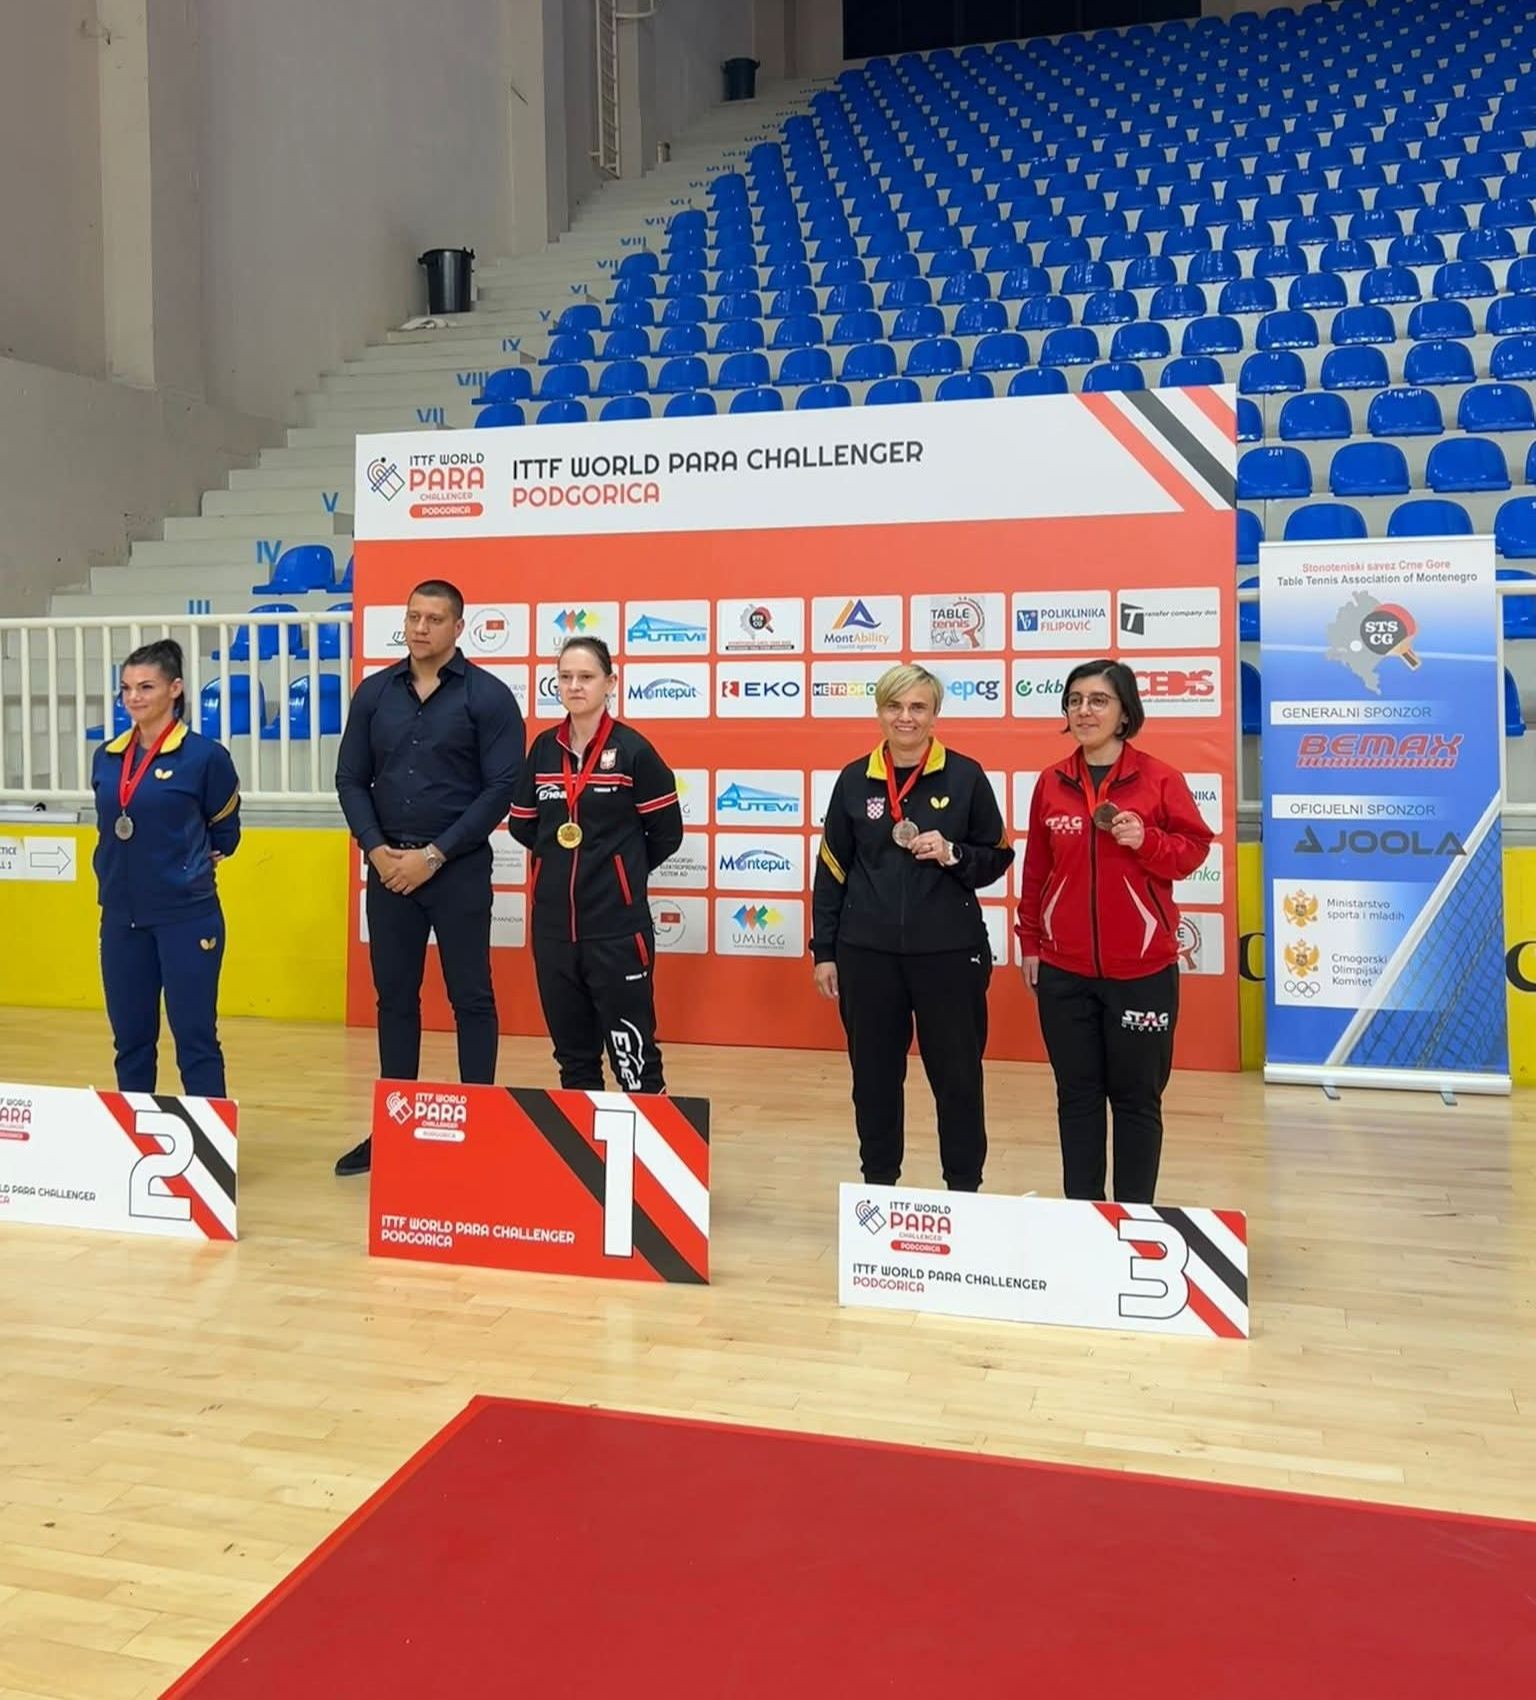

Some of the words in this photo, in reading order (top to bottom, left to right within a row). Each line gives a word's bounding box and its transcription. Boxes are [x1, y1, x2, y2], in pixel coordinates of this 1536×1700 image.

[409, 455, 436, 467] ITTF
[440, 452, 485, 466] WORLD
[513, 458, 562, 480] ITTF
[571, 453, 660, 478] WORLD
[669, 449, 738, 474] PARA
[747, 440, 924, 471] CHALLENGER
[409, 466, 485, 492] PARA
[322, 491, 339, 513] V
[513, 482, 660, 508] PODGORICA
[256, 539, 283, 564] IV
[1302, 562, 1366, 573] Stonoteniski
[1368, 562, 1396, 572] savez
[1398, 560, 1425, 570] Crne
[1426, 559, 1452, 570] Gore
[1277, 577, 1303, 587] Table
[1306, 575, 1339, 585] Tennis
[1341, 573, 1400, 585] Association
[1403, 573, 1415, 583] of
[1416, 572, 1478, 584] Montenegro
[931, 608, 970, 620] TABLE
[1041, 607, 1107, 619] POLIKLINIKA
[932, 619, 971, 629] tennis
[1041, 619, 1092, 631] FILIPOVIĆ
[1364, 620, 1398, 633] STS
[824, 632, 891, 646] MontAbility
[1369, 633, 1394, 645] CG
[628, 682, 697, 700] Monteput
[744, 681, 801, 698] EKO
[951, 679, 1000, 701] epcg
[1282, 706, 1360, 719] GENERALNI
[1364, 706, 1432, 719] SPONZOR
[1299, 733, 1465, 758] BEMAX
[1290, 803, 1363, 816] OFICIJELNI
[1368, 803, 1436, 816] SPONZOR
[1328, 829, 1468, 856] JOOLA
[720, 854, 791, 873] Monteput
[1326, 898, 1391, 910] Ministarstvo
[1327, 910, 1360, 922] sporta
[1369, 910, 1405, 922] mladih
[732, 933, 786, 946] UMHCG
[1332, 952, 1388, 965] Crnogorski
[1332, 965, 1383, 977] Olimpijski
[1332, 977, 1373, 988] Komitet
[1121, 1009, 1169, 1026] STAG
[611, 1029, 642, 1090] Enea
[433, 1093, 468, 1105] WORLD
[0, 1106, 32, 1124] ARA
[415, 1104, 468, 1123] PARA
[129, 1109, 195, 1221] 2
[592, 1107, 636, 1259] 1
[38, 1187, 97, 1202] CHALLENGER
[889, 1200, 911, 1211] ITTF
[914, 1202, 952, 1215] WORLD
[381, 1213, 406, 1227] ITTF
[409, 1216, 453, 1233] WORLD
[455, 1221, 489, 1237] PARA
[492, 1224, 576, 1245] CHALLENGER
[890, 1211, 952, 1235] PARA
[381, 1229, 454, 1248] PODGORICA
[1117, 1216, 1190, 1320] 3
[853, 1262, 878, 1275] ITTF
[881, 1265, 925, 1280] WORLD
[928, 1269, 962, 1284] PARA
[965, 1273, 1048, 1292] CHALLENGER
[853, 1275, 925, 1293] PODGORICA
